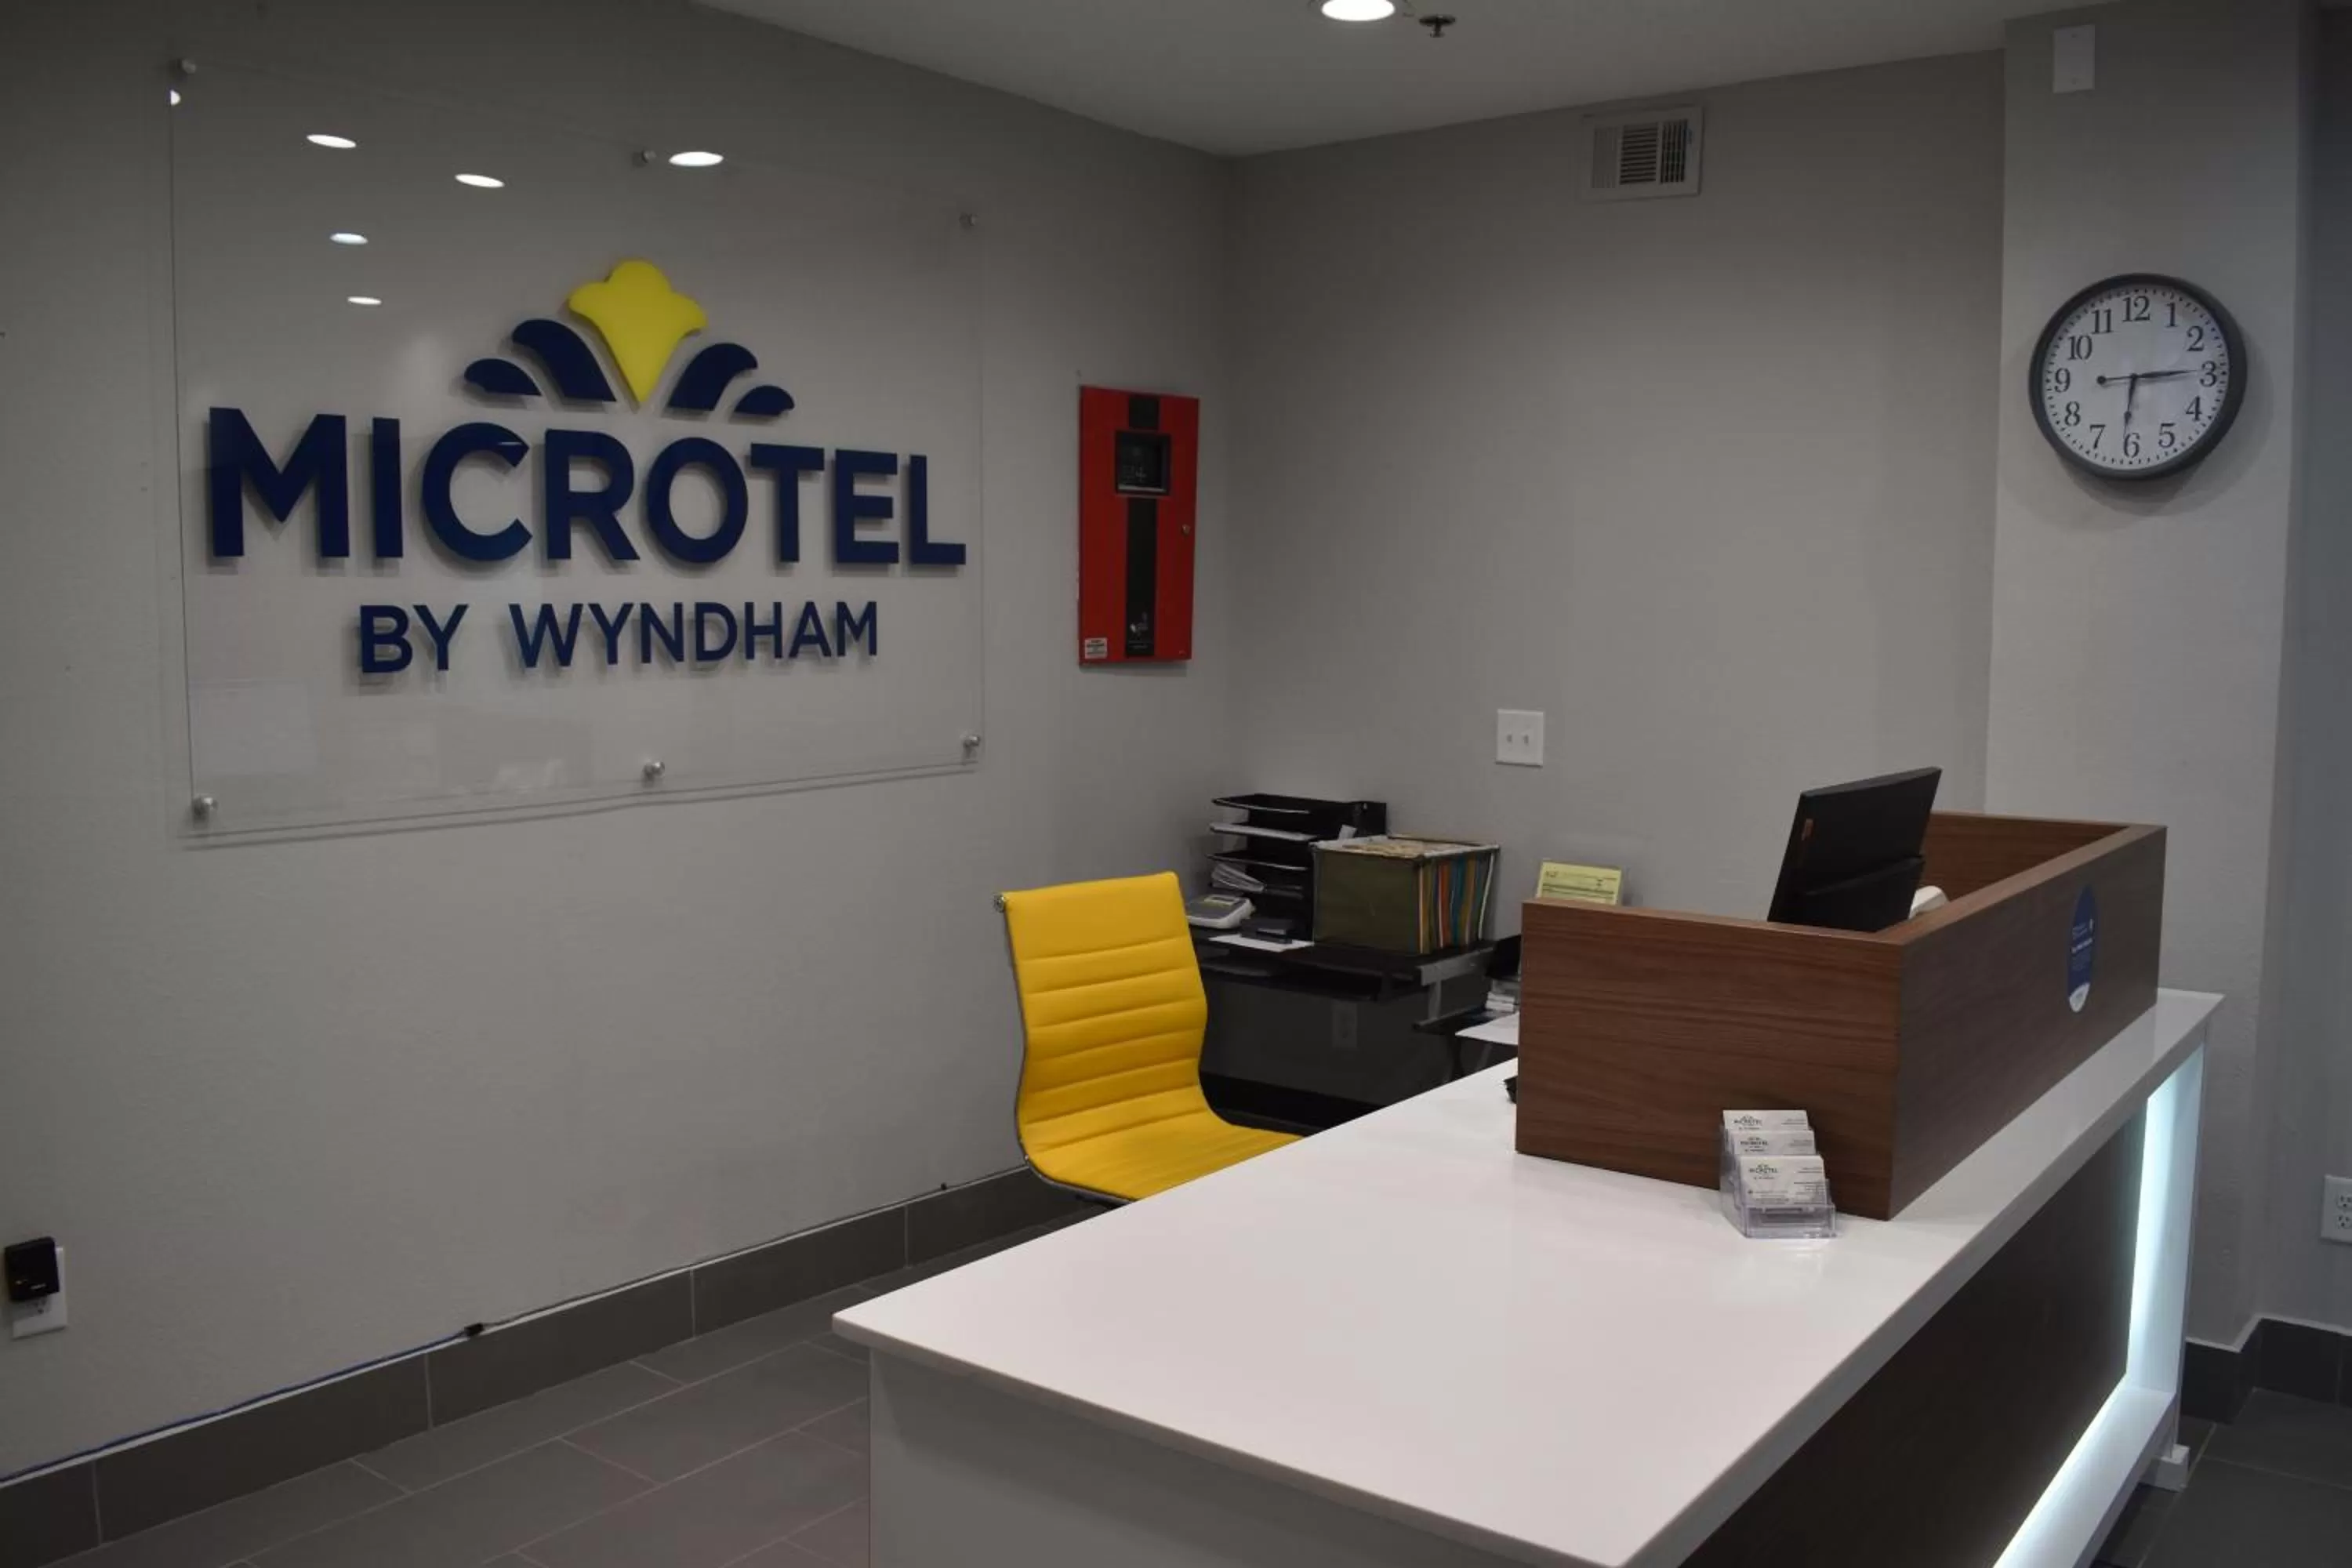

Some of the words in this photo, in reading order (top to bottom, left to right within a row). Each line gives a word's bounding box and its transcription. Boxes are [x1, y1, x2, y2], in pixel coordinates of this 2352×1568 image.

[2091, 308, 2114, 334] 11
[2122, 296, 2151, 322] 12
[2165, 302, 2178, 328] 1
[2067, 335, 2092, 361] 10
[2187, 325, 2205, 352] 2
[2054, 368, 2071, 393] 9
[2199, 361, 2216, 387] 3
[2064, 401, 2081, 426] 8
[2185, 396, 2202, 422] 4
[2089, 424, 2106, 449] 7
[2123, 432, 2140, 458] 6
[2158, 423, 2176, 448] 5
[209, 407, 966, 565] MICROTEL
[360, 604, 469, 673] BY
[509, 601, 878, 669] WYNDHAM
